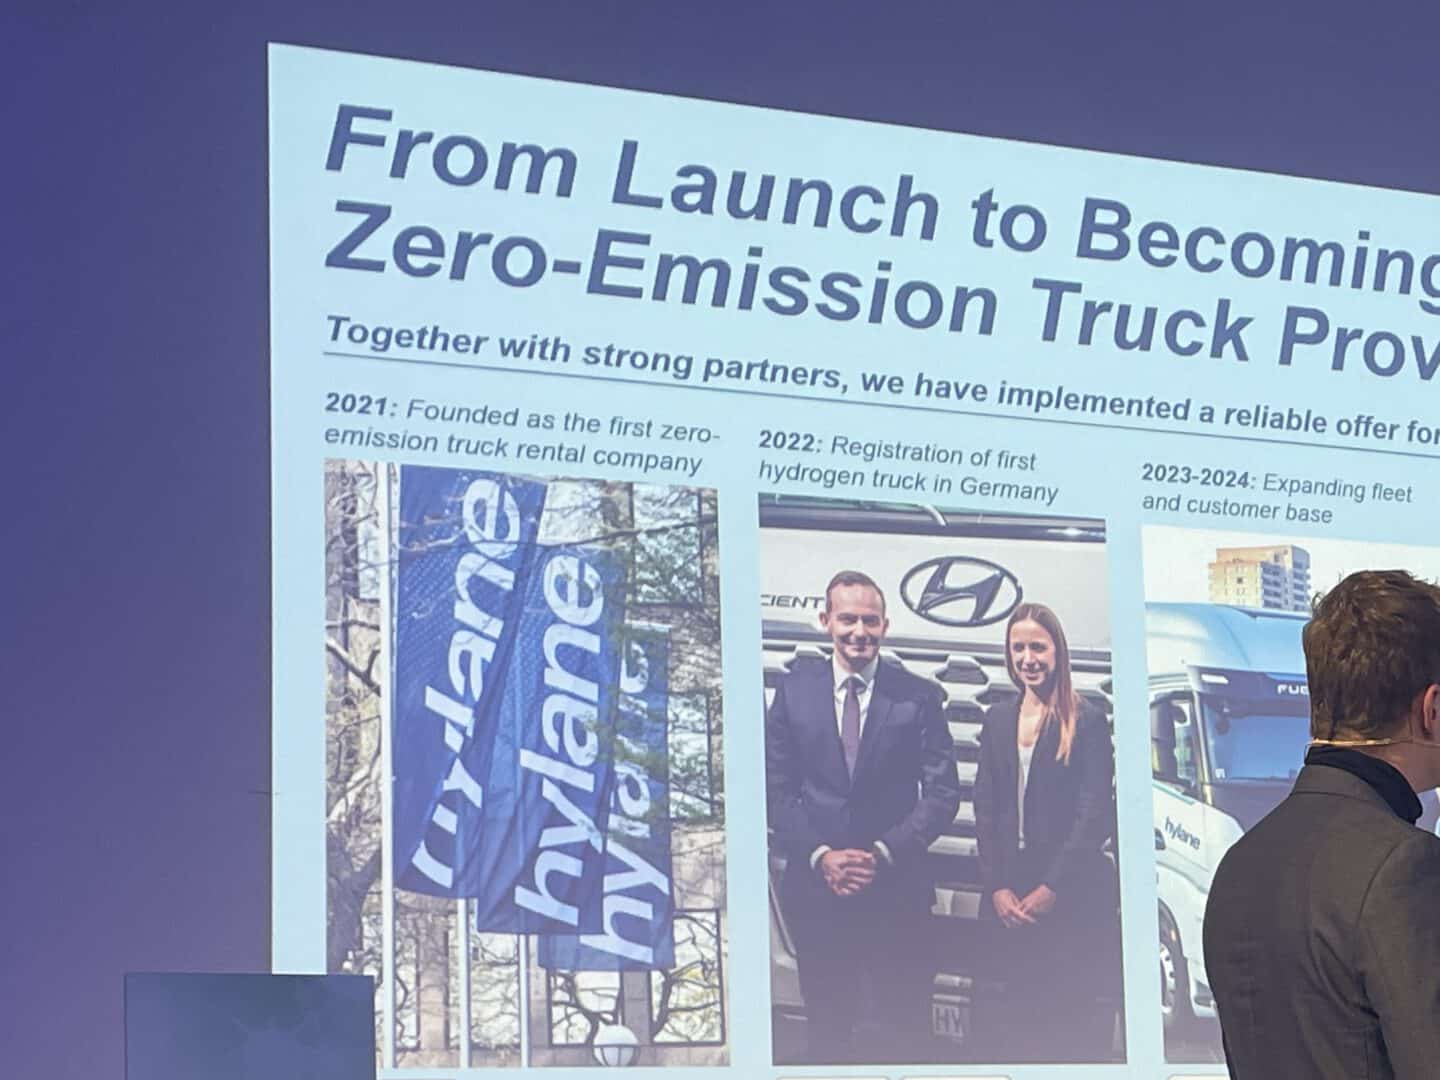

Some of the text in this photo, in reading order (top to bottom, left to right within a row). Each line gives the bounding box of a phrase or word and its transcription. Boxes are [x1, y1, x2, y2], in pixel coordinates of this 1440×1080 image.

[324, 103, 578, 199] From
[610, 139, 940, 242] Launch
[970, 187, 1048, 253] to
[324, 199, 998, 337] Zero-Emission
[1031, 277, 1256, 363] Truck
[326, 314, 491, 356] Together
[498, 333, 572, 364] with
[581, 343, 694, 381] strong
[702, 357, 849, 395] partners,
[860, 371, 905, 395] we
[913, 371, 989, 403] have
[997, 379, 1192, 422] implemented
[1198, 405, 1215, 425] a
[1223, 403, 1328, 435] reliable
[1335, 413, 1401, 441] offer
[324, 391, 721, 444] 2021: Founded as the first zero-
[324, 426, 703, 478] emission truck rental company
[758, 429, 1037, 472] 2022: Registration of first
[758, 459, 1059, 508] hydrogen truck in Germany
[1141, 462, 1413, 504] 2023-2024: Expanding fleet
[1141, 493, 1334, 525] and customer base
[514, 553, 605, 926] hylane
[1164, 816, 1201, 850] hylane
